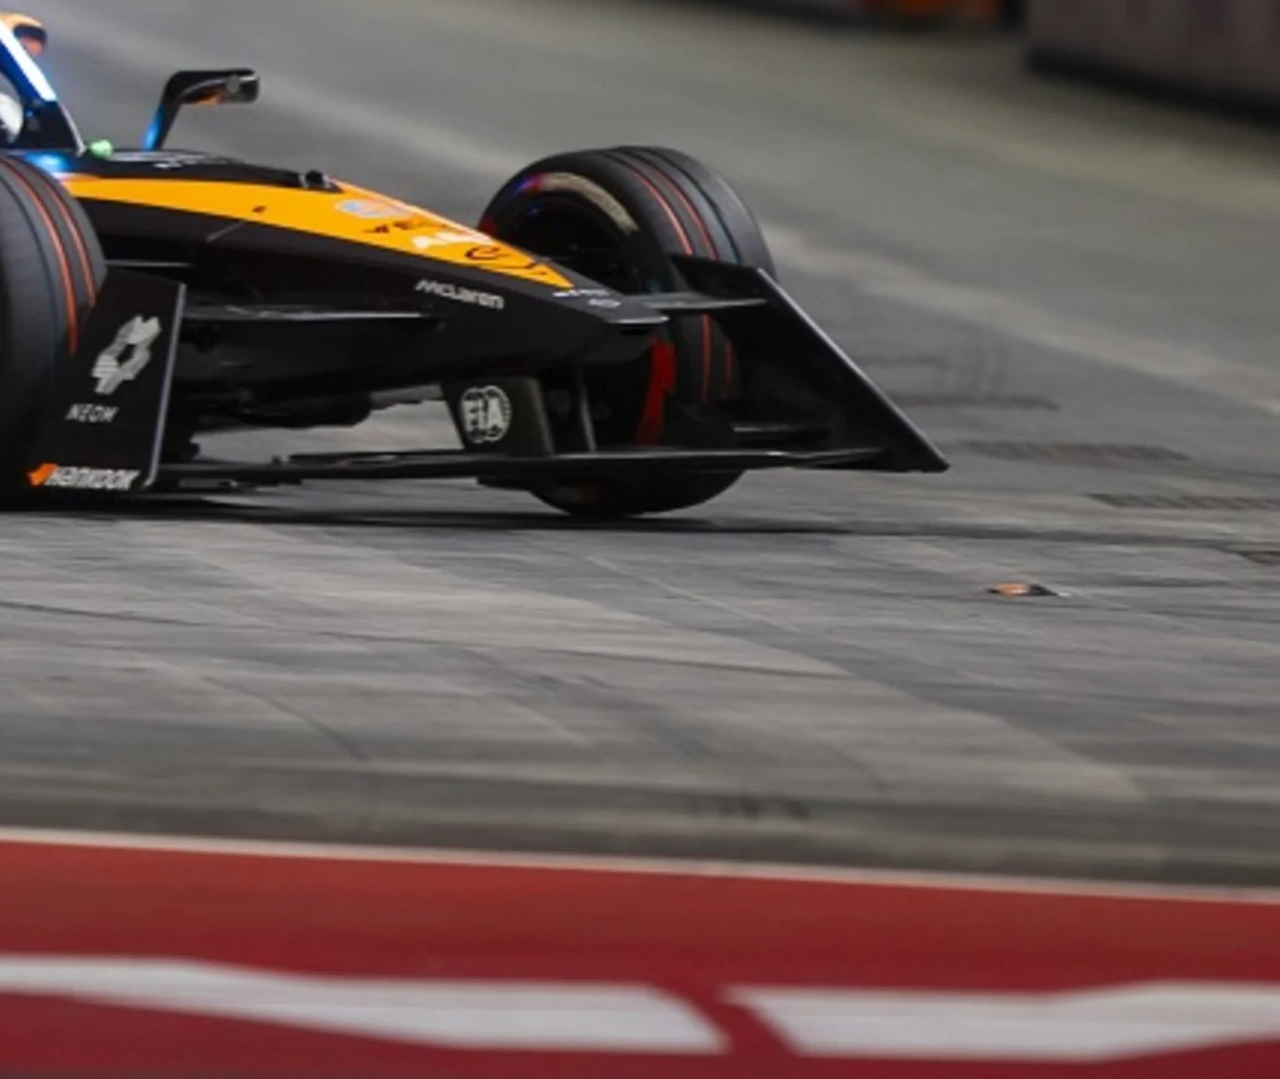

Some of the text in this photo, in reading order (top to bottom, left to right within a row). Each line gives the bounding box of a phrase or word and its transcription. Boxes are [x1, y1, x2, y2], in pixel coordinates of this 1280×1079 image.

[414, 278, 506, 310] McLaren
[64, 402, 121, 424] NEOM
[461, 397, 507, 433] FIA
